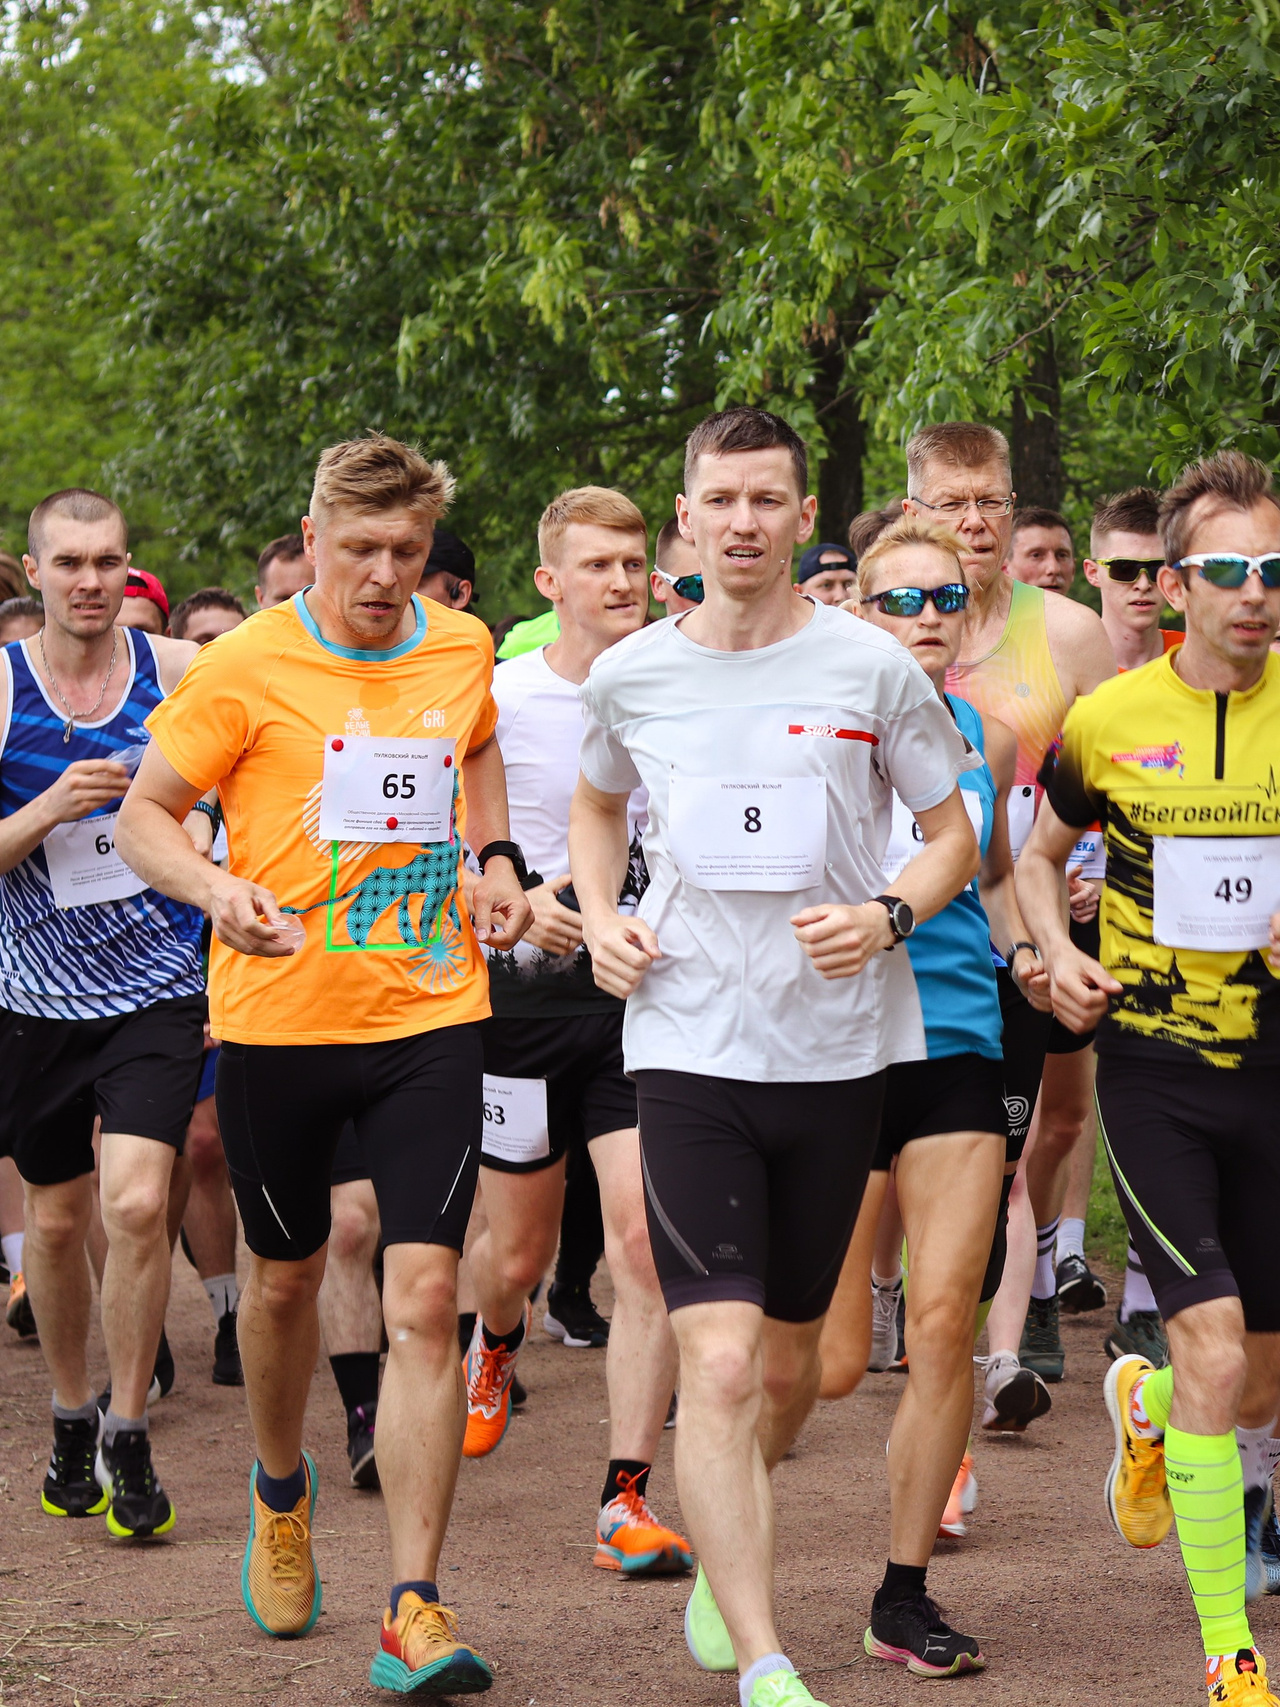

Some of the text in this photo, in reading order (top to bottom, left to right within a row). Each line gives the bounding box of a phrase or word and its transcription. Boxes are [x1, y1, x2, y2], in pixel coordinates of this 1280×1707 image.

[344, 720, 370, 730] БЕЛЫЕ
[382, 773, 416, 799] 65
[744, 806, 762, 833] 8
[95, 834, 115, 855] 6
[1214, 876, 1252, 904] 49
[483, 1102, 506, 1125] 63
